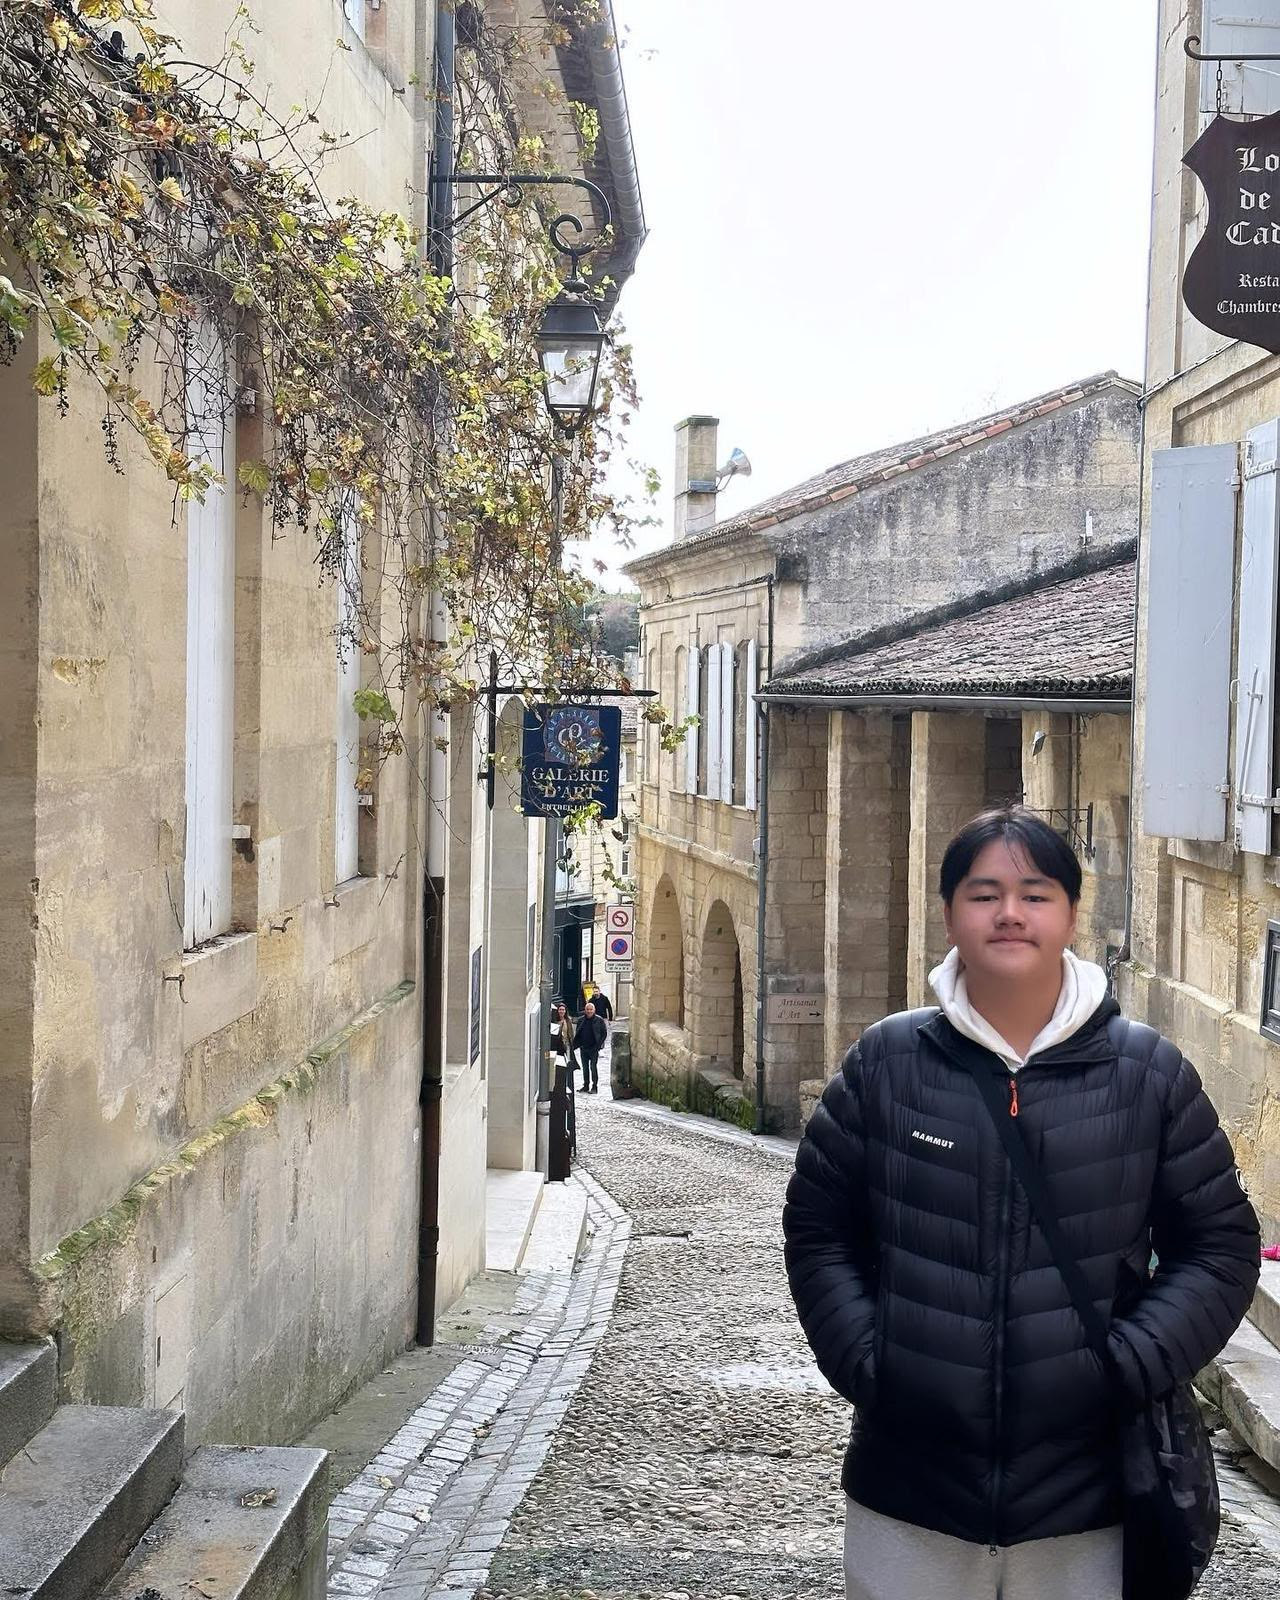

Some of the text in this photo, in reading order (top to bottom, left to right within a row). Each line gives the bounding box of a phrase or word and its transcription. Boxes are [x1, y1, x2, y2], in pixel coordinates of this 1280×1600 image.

[1235, 147, 1280, 174] Lo
[1239, 187, 1271, 210] de
[1238, 273, 1280, 288] Resta
[532, 767, 609, 782] GALERIE
[912, 1130, 954, 1149] MAMMUT
